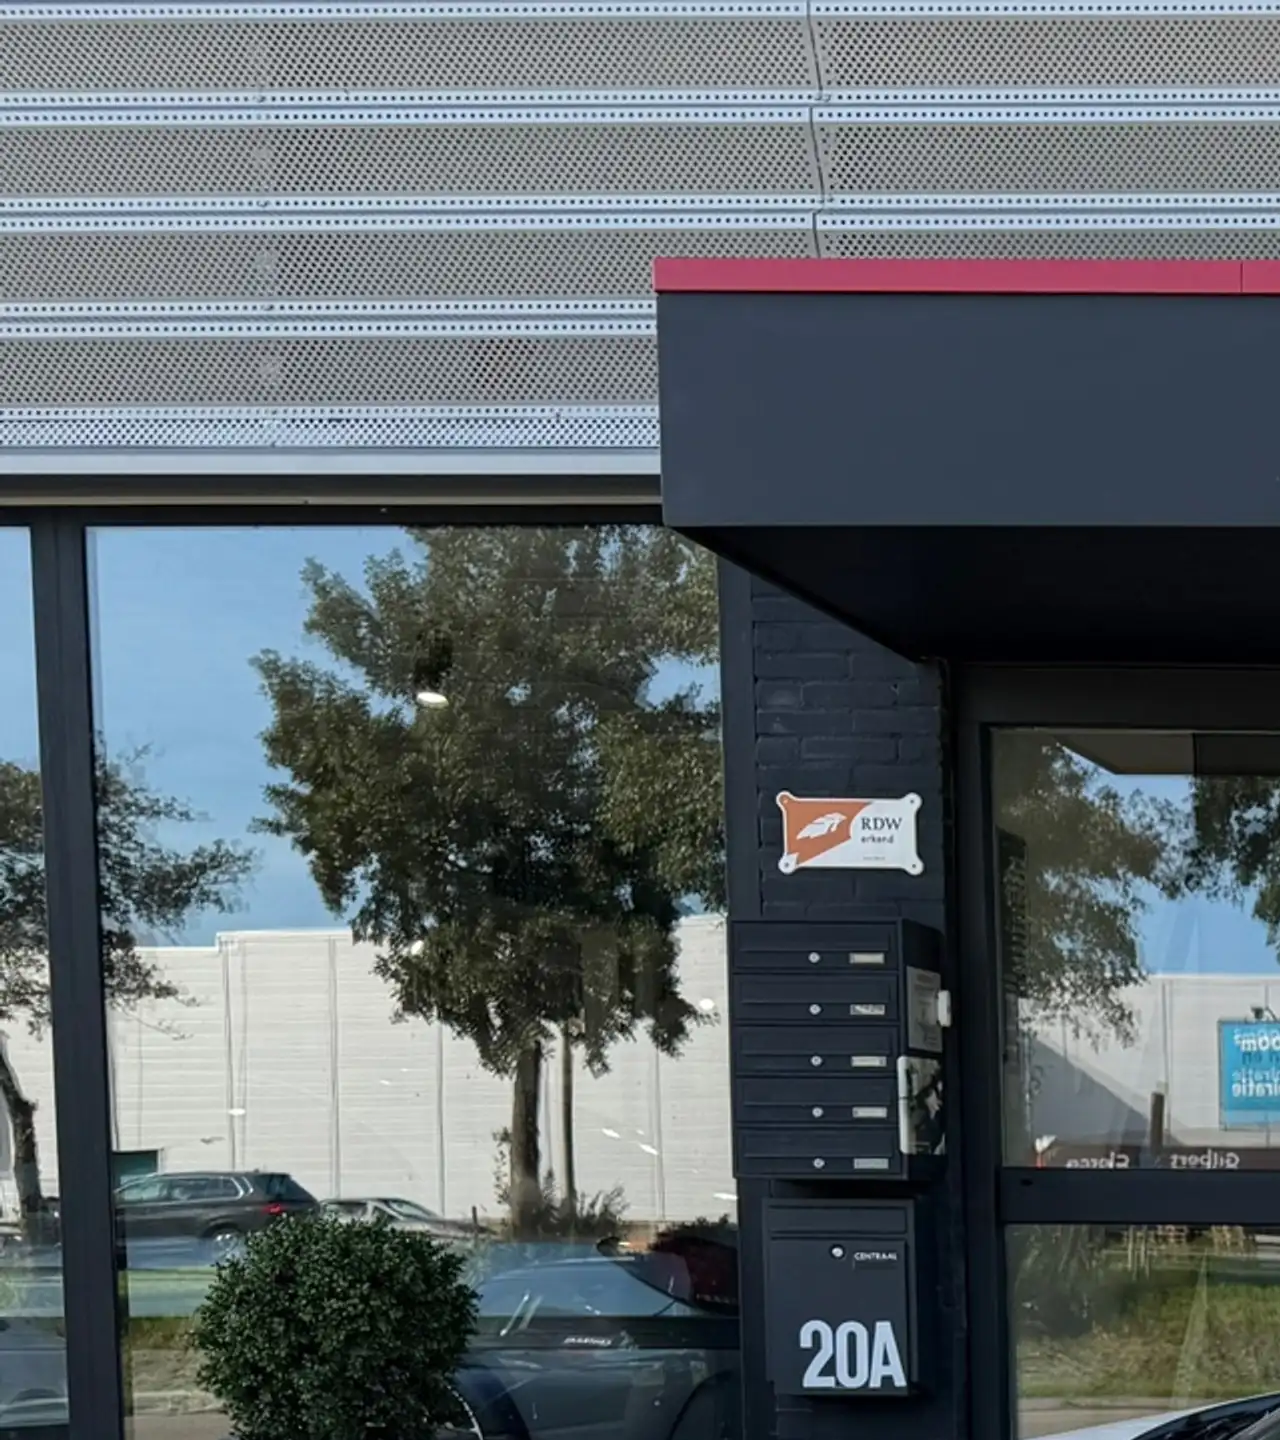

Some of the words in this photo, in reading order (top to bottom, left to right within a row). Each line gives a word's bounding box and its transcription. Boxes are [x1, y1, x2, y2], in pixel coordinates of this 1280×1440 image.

[861, 816, 902, 831] RDW
[861, 834, 894, 844] erkend
[800, 1320, 907, 1388] 20A
